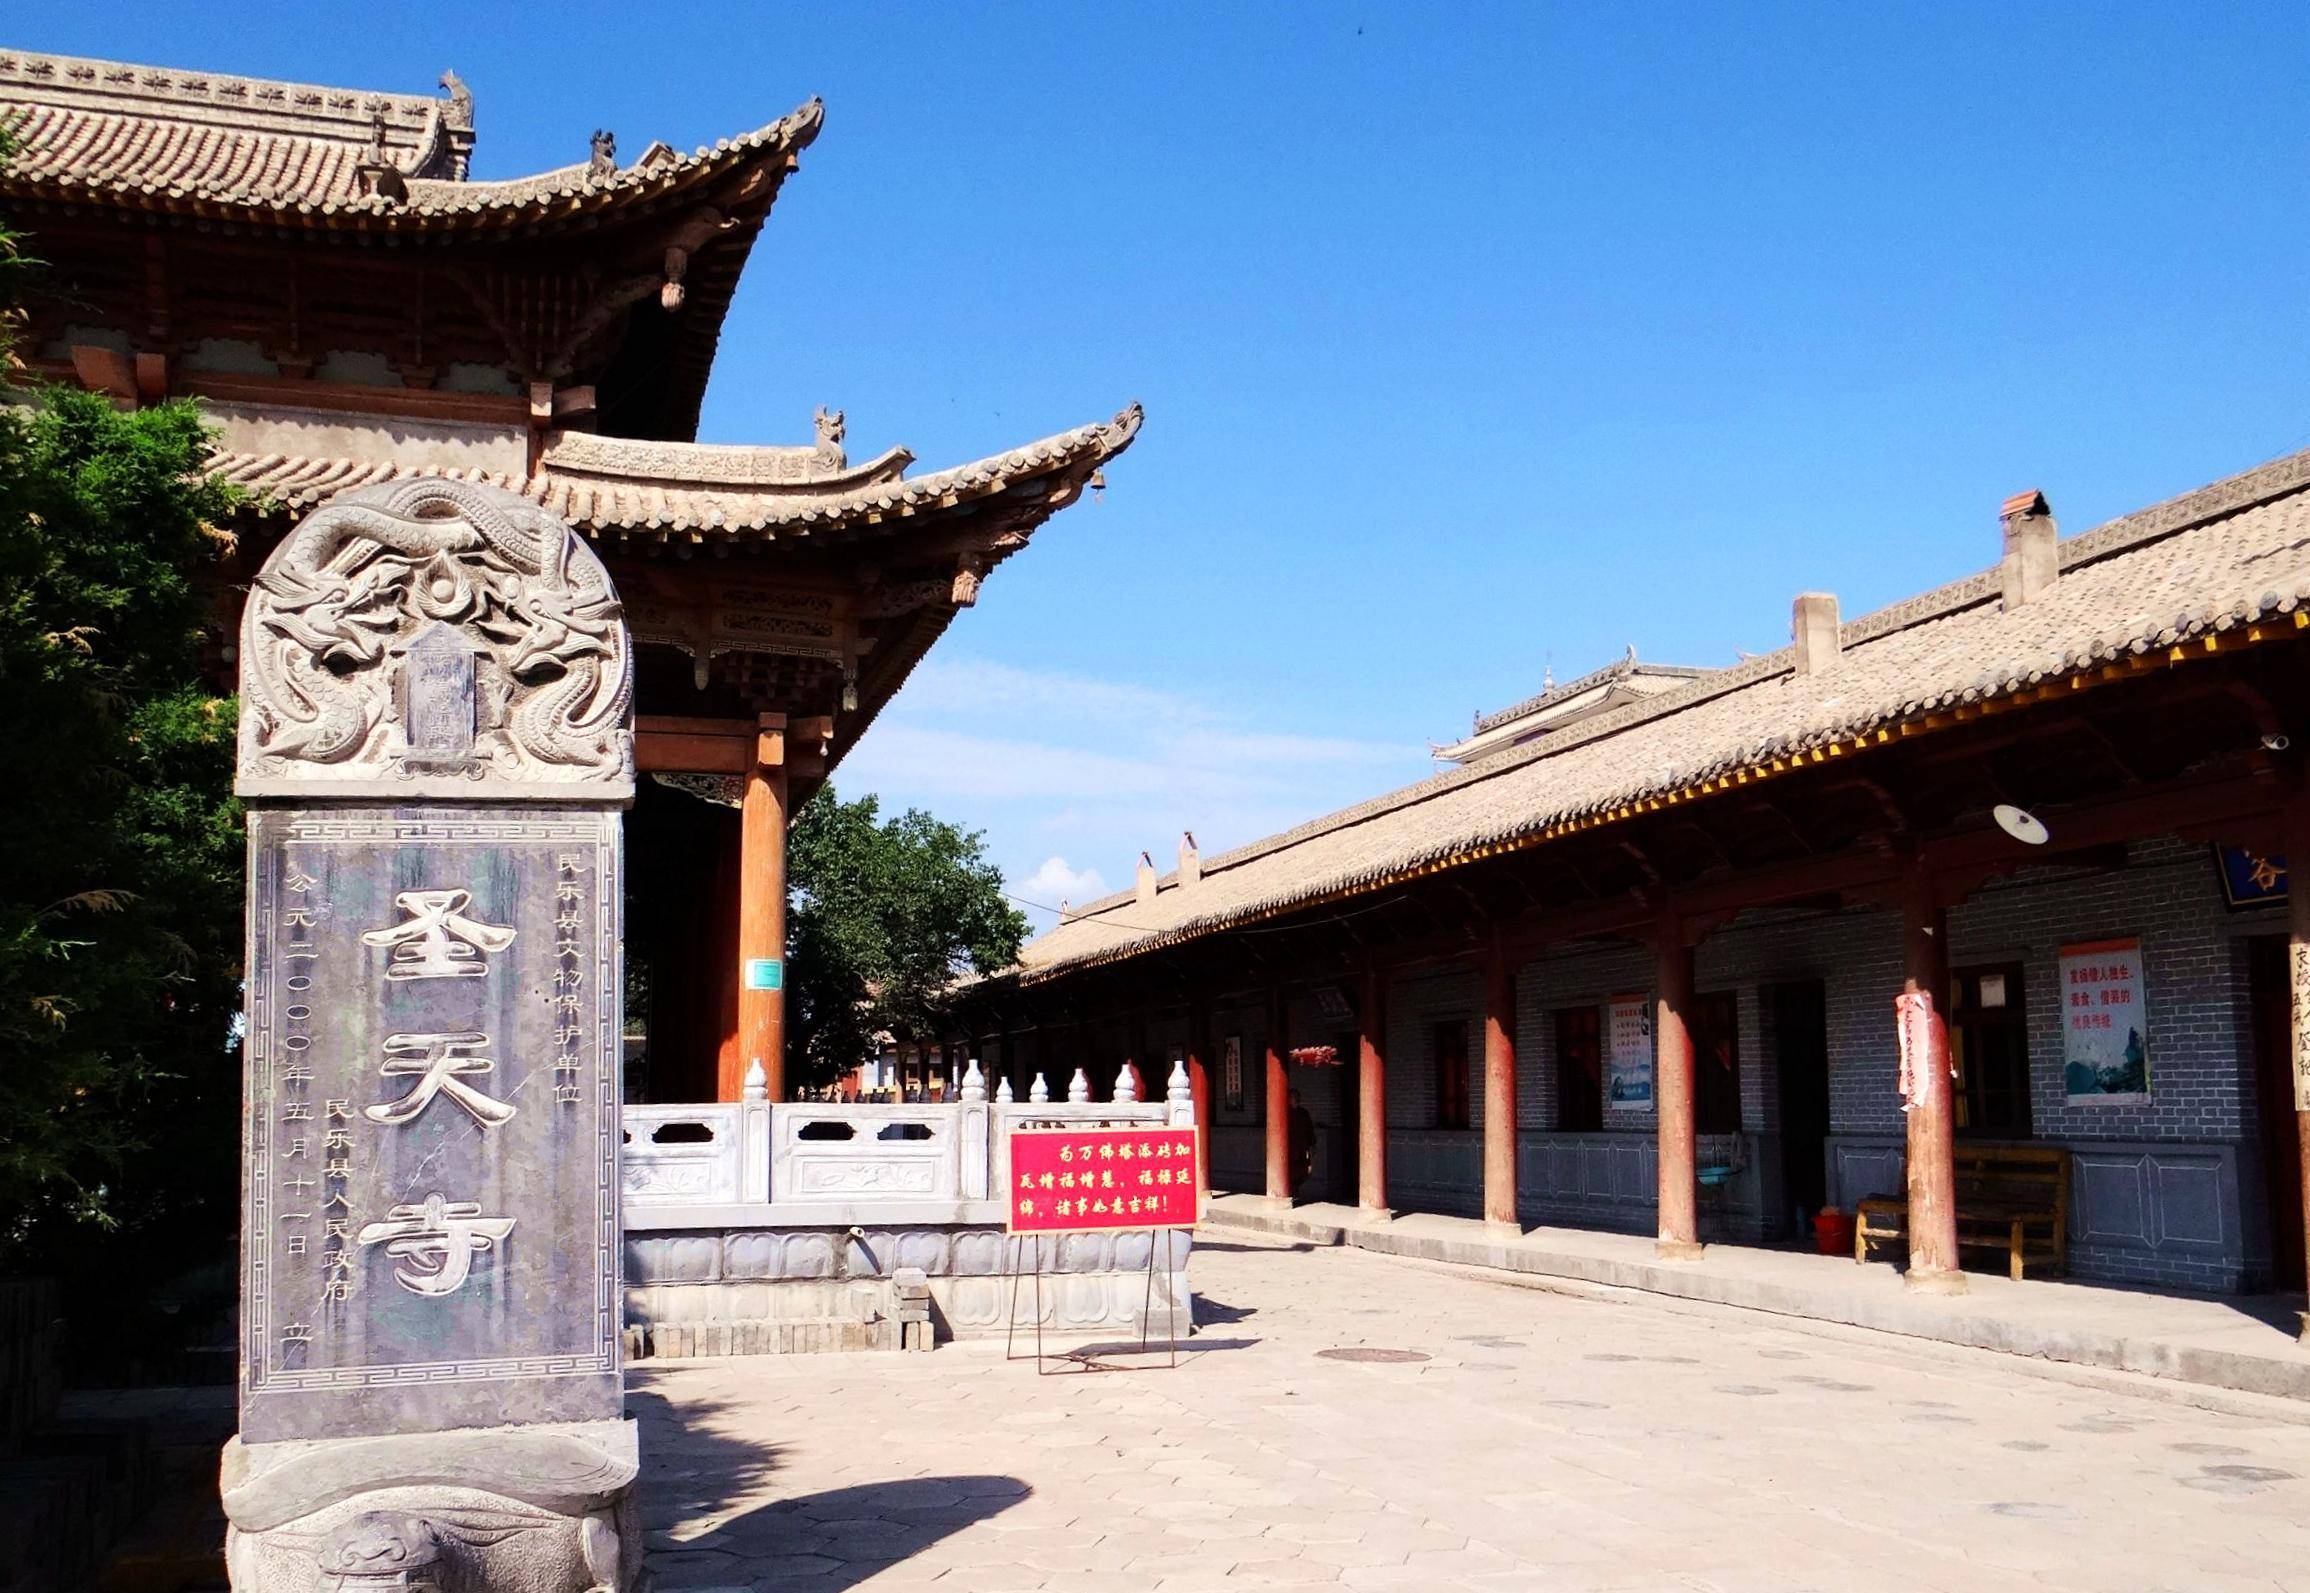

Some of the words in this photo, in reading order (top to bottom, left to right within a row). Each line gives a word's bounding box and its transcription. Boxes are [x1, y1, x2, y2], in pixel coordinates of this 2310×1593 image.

[358, 889, 518, 1295] 圣天寺
[552, 852, 587, 1104] 民乐县文物保护单位
[322, 1098, 357, 1301] 民乐县人民政府
